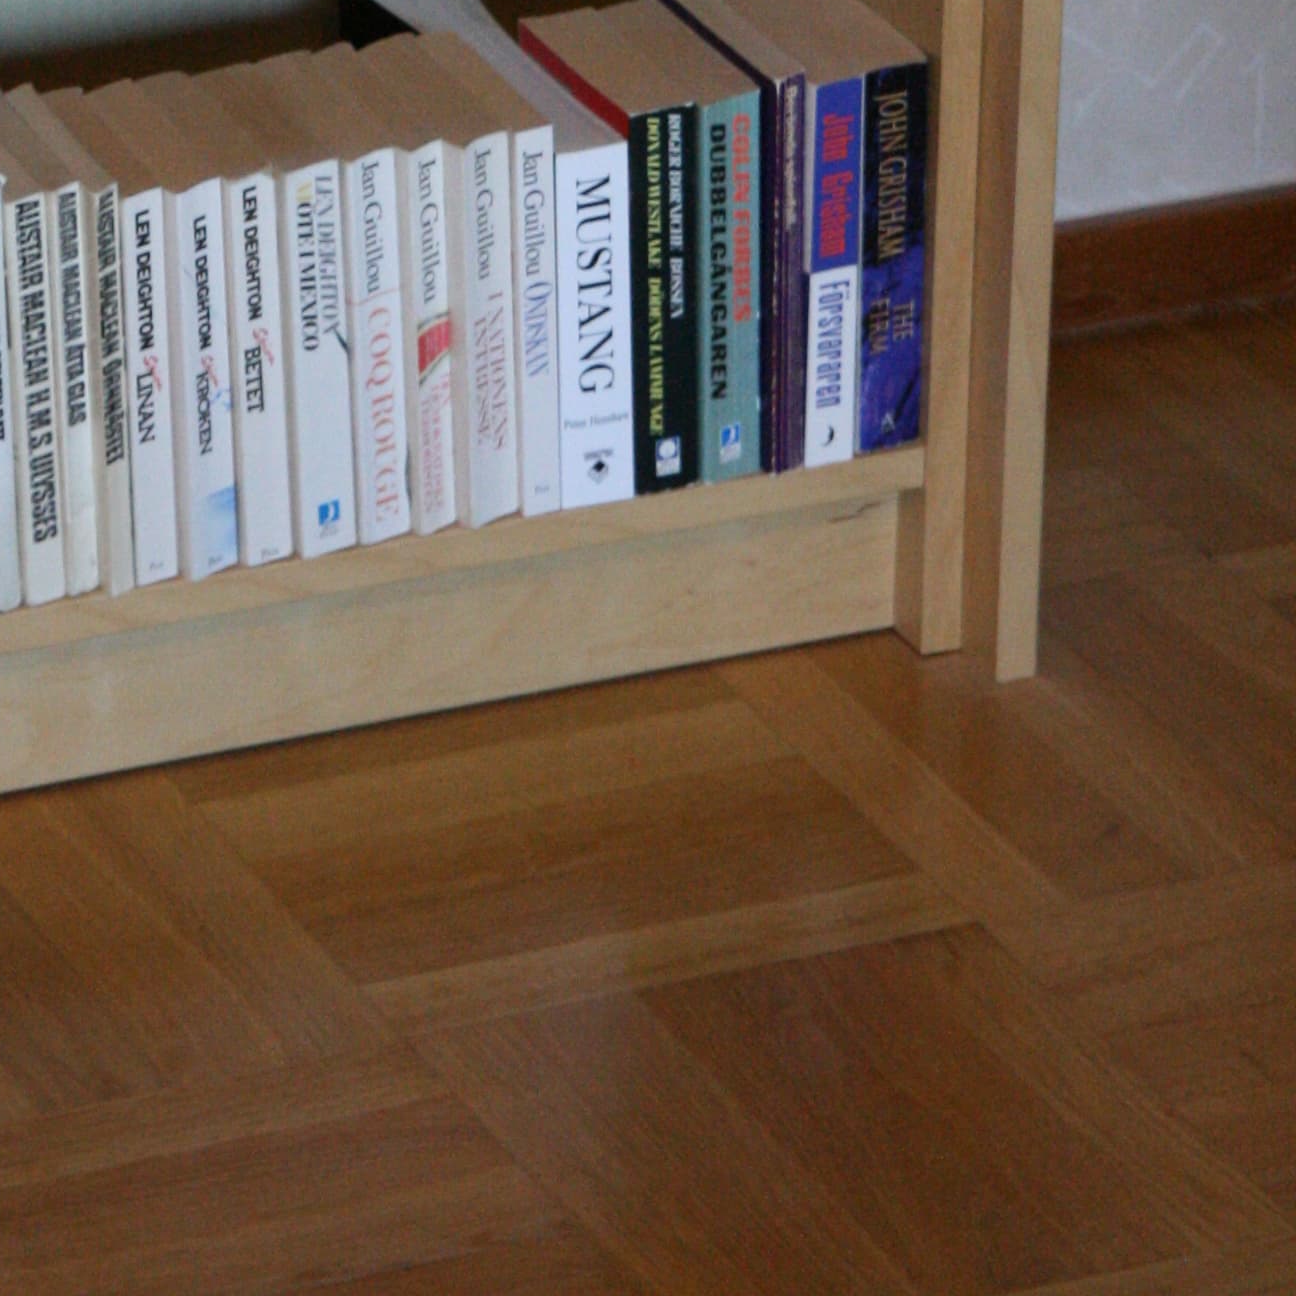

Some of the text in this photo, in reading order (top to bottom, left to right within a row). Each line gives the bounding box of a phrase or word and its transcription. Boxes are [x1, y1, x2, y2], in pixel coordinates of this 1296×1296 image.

[521, 151, 546, 276] Jan Guillou
[667, 114, 683, 168] ROGER
[873, 90, 908, 261] JOHN GRISHAM
[135, 211, 154, 350] LEN DEIGHTON
[242, 186, 262, 320] LEN DEIGHTON
[416, 159, 440, 304] Jan Guillou
[575, 174, 615, 394] MUSTANG
[709, 124, 732, 399] DUBBELGÅNGAREN
[732, 114, 751, 322] COLIN FORBES
[15, 200, 48, 386] ALISTAIR MACLEAN
[815, 281, 851, 409] Försvararen
[25, 392, 57, 543] H.M.S. ULYSSES
